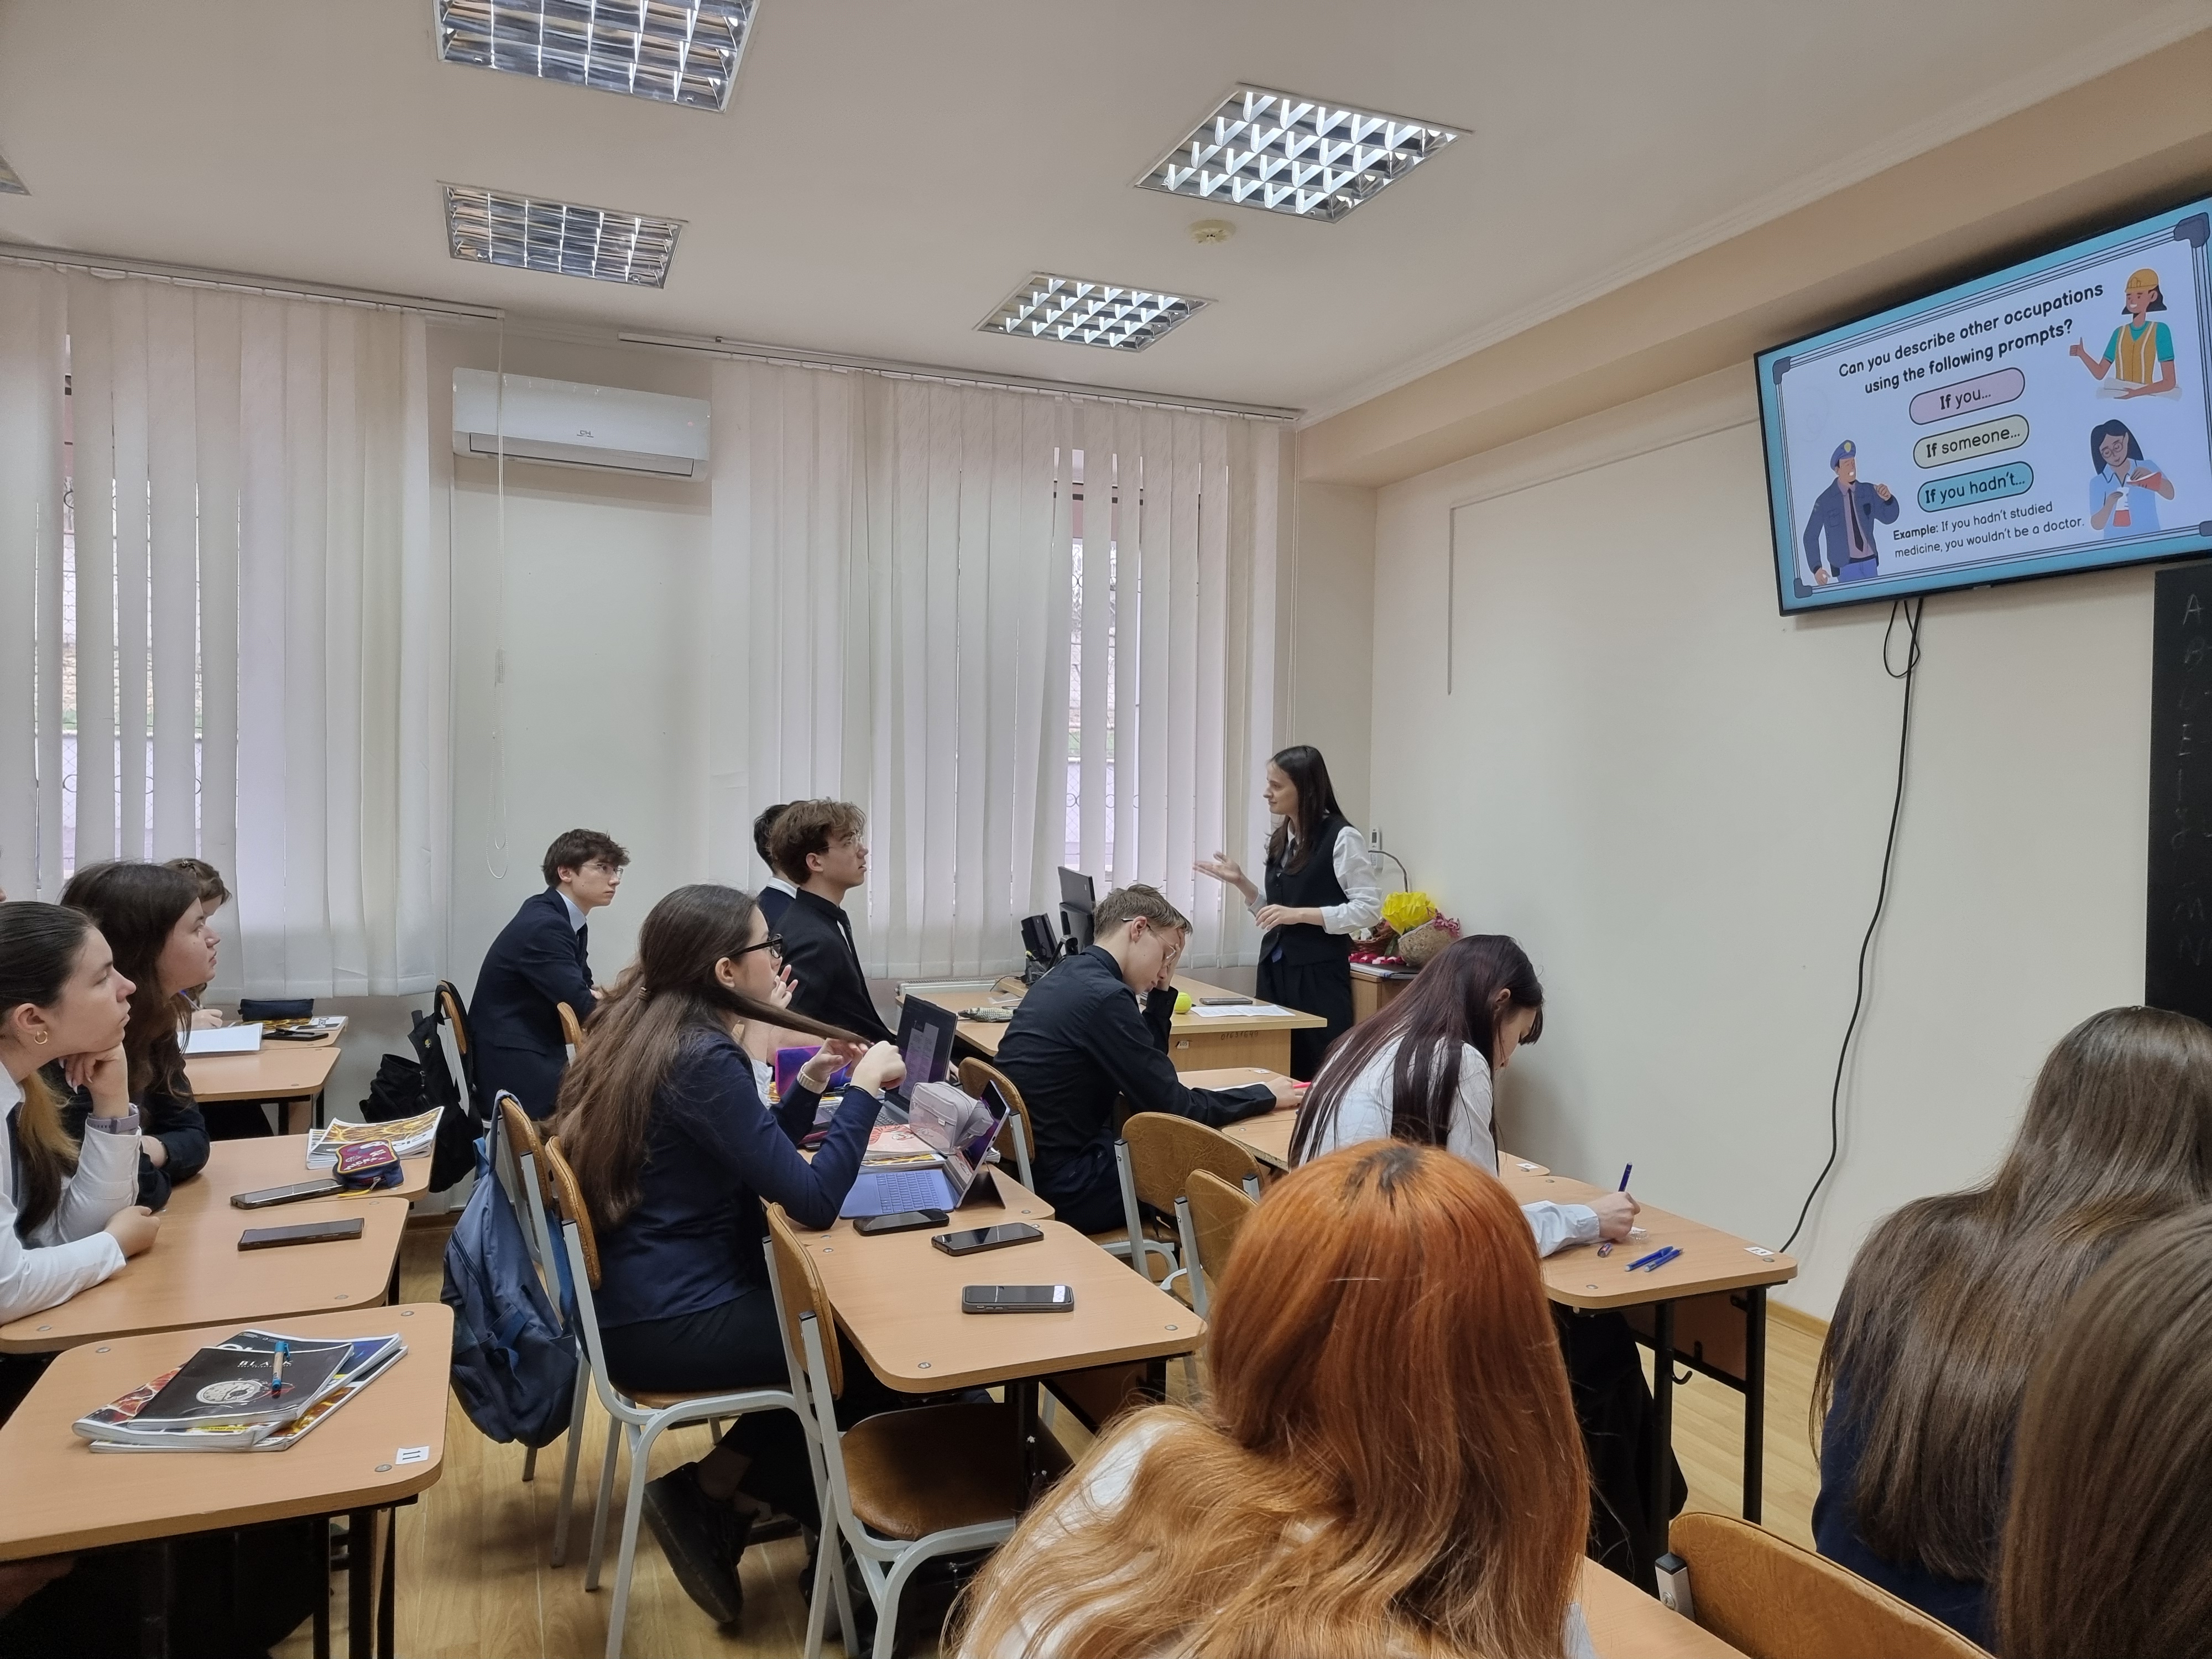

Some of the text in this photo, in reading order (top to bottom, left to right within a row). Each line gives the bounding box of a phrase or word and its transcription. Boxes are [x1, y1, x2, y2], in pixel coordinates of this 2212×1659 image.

[1839, 284, 2104, 377] Can you describe other occupations
[1865, 319, 2073, 394] using the following prompts?
[1939, 389, 1991, 410] If you...
[1926, 429, 2020, 458] If someone...
[1925, 489, 1936, 504] If
[1939, 486, 1965, 504] you
[1893, 500, 2053, 541] Example: If you hadn't studied
[1895, 518, 2085, 558] medicine, you wouldn't be a doctor.
[2182, 593, 2205, 626] A
[2177, 723, 2193, 757] E
